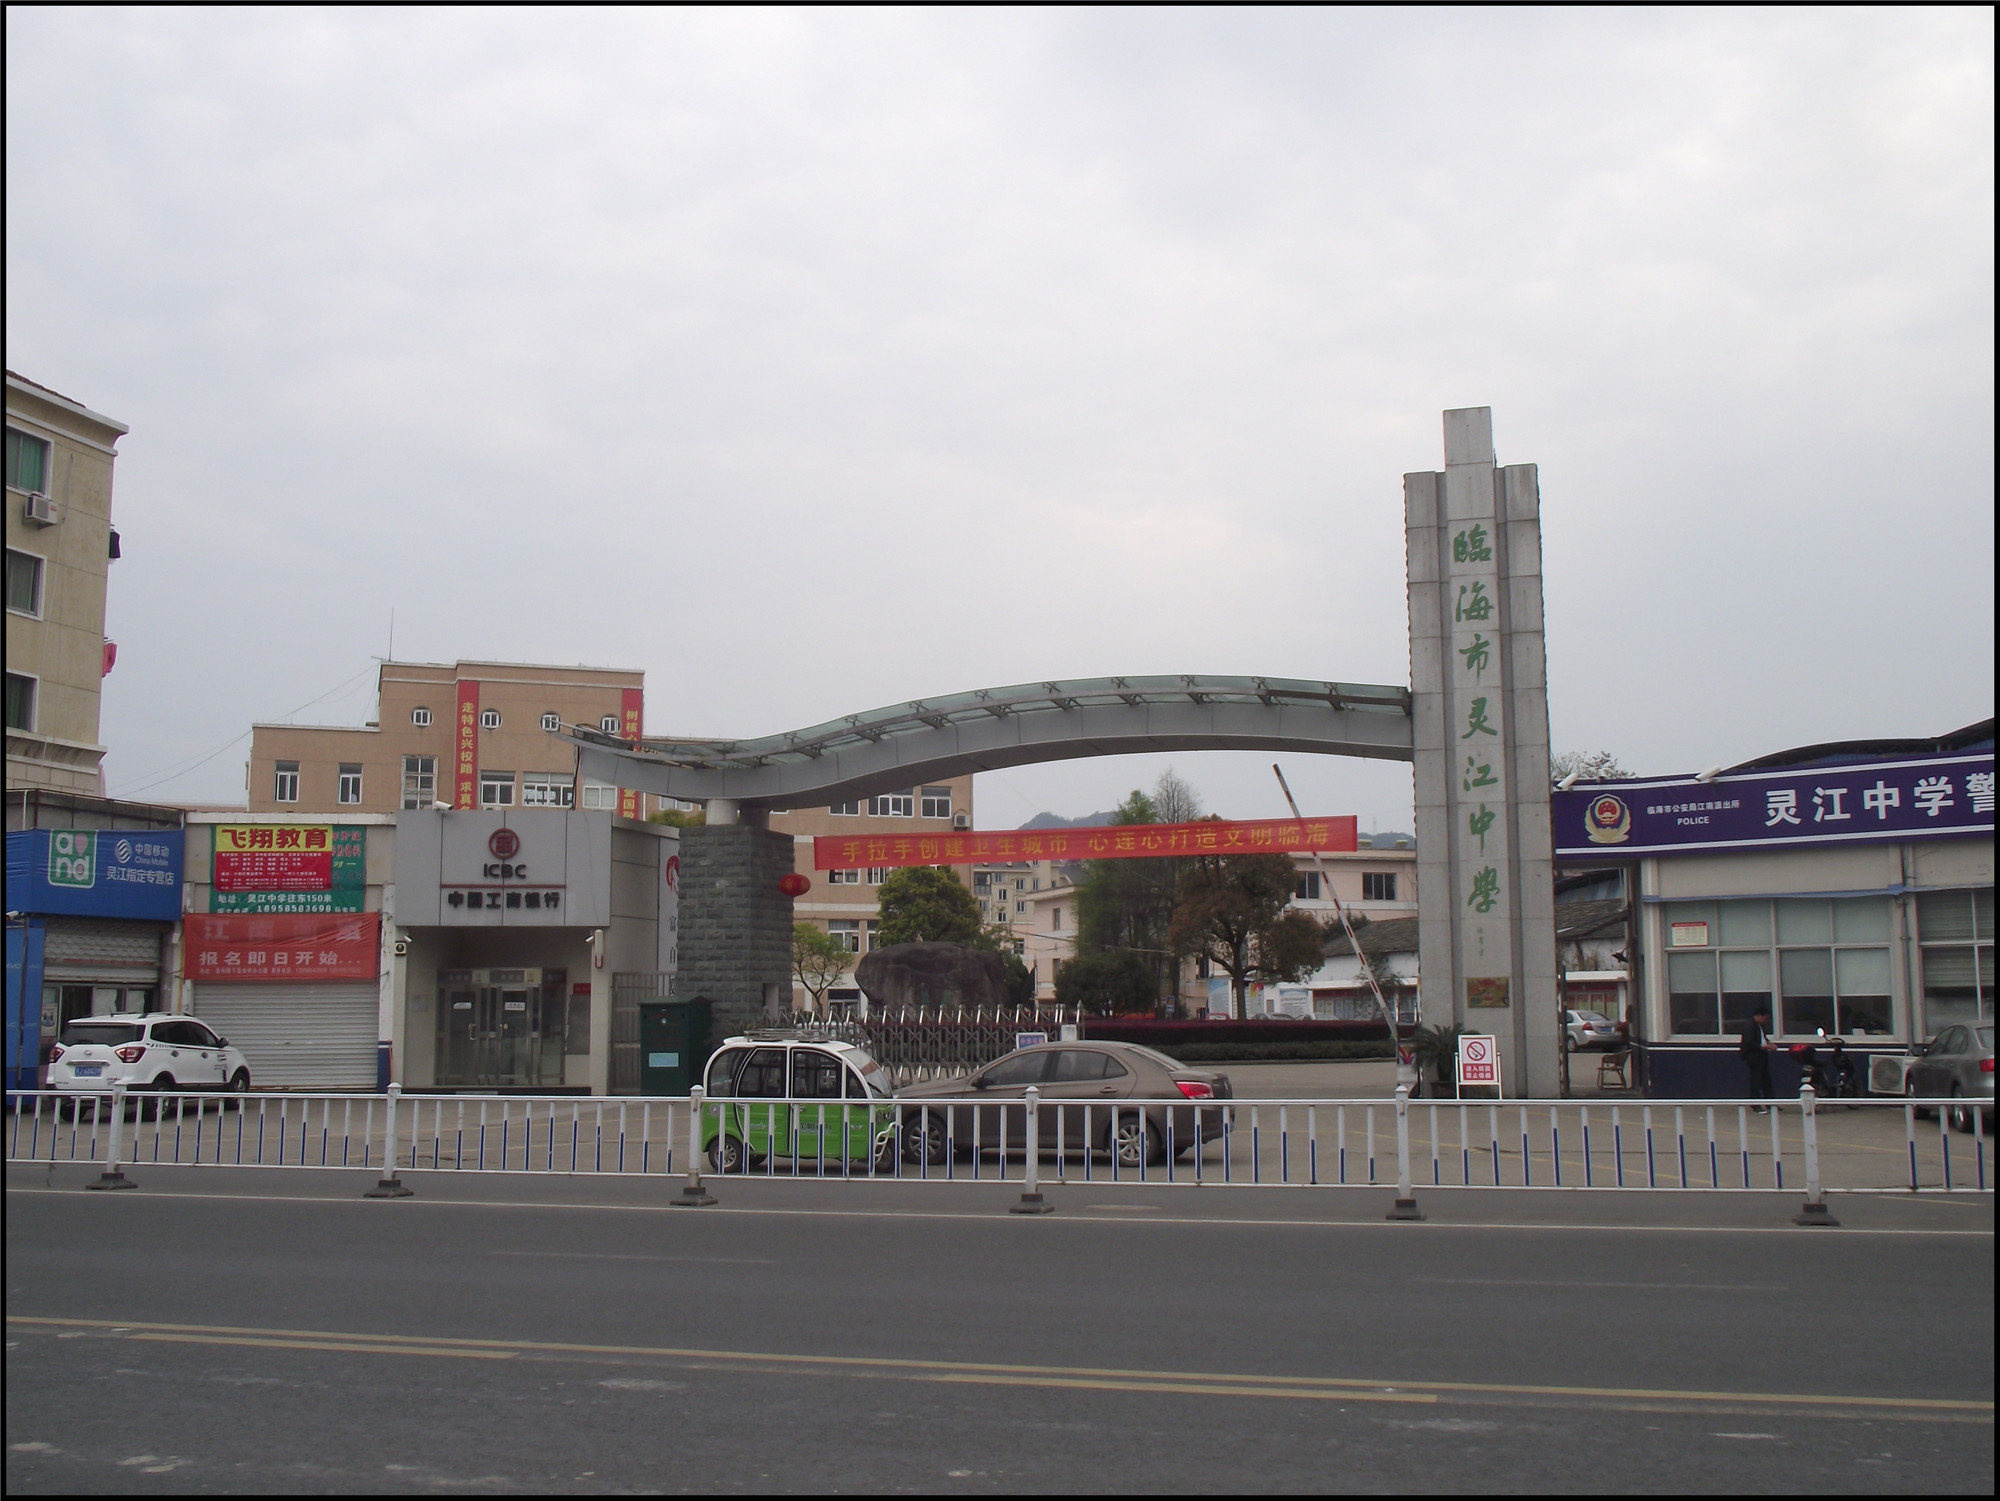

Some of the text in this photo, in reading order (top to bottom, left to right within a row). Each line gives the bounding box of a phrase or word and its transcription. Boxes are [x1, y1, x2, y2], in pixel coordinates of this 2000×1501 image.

[459, 702, 475, 811] 走特色兴校路 求真
[1646, 799, 1740, 815] 临海市公安局江南派出所
[1765, 771, 1995, 827] 灵江中学警
[1677, 815, 1710, 826] POLICE
[221, 828, 329, 849] 飞翔教育
[842, 823, 1329, 863] 手拉手创建卫生城市 心连心打造文明临海
[135, 843, 169, 857] 中国移动
[134, 857, 150, 865] China
[483, 863, 527, 878] ICBC
[106, 866, 176, 886] 灵江指定专营店
[448, 890, 560, 909] 中国工商银行
